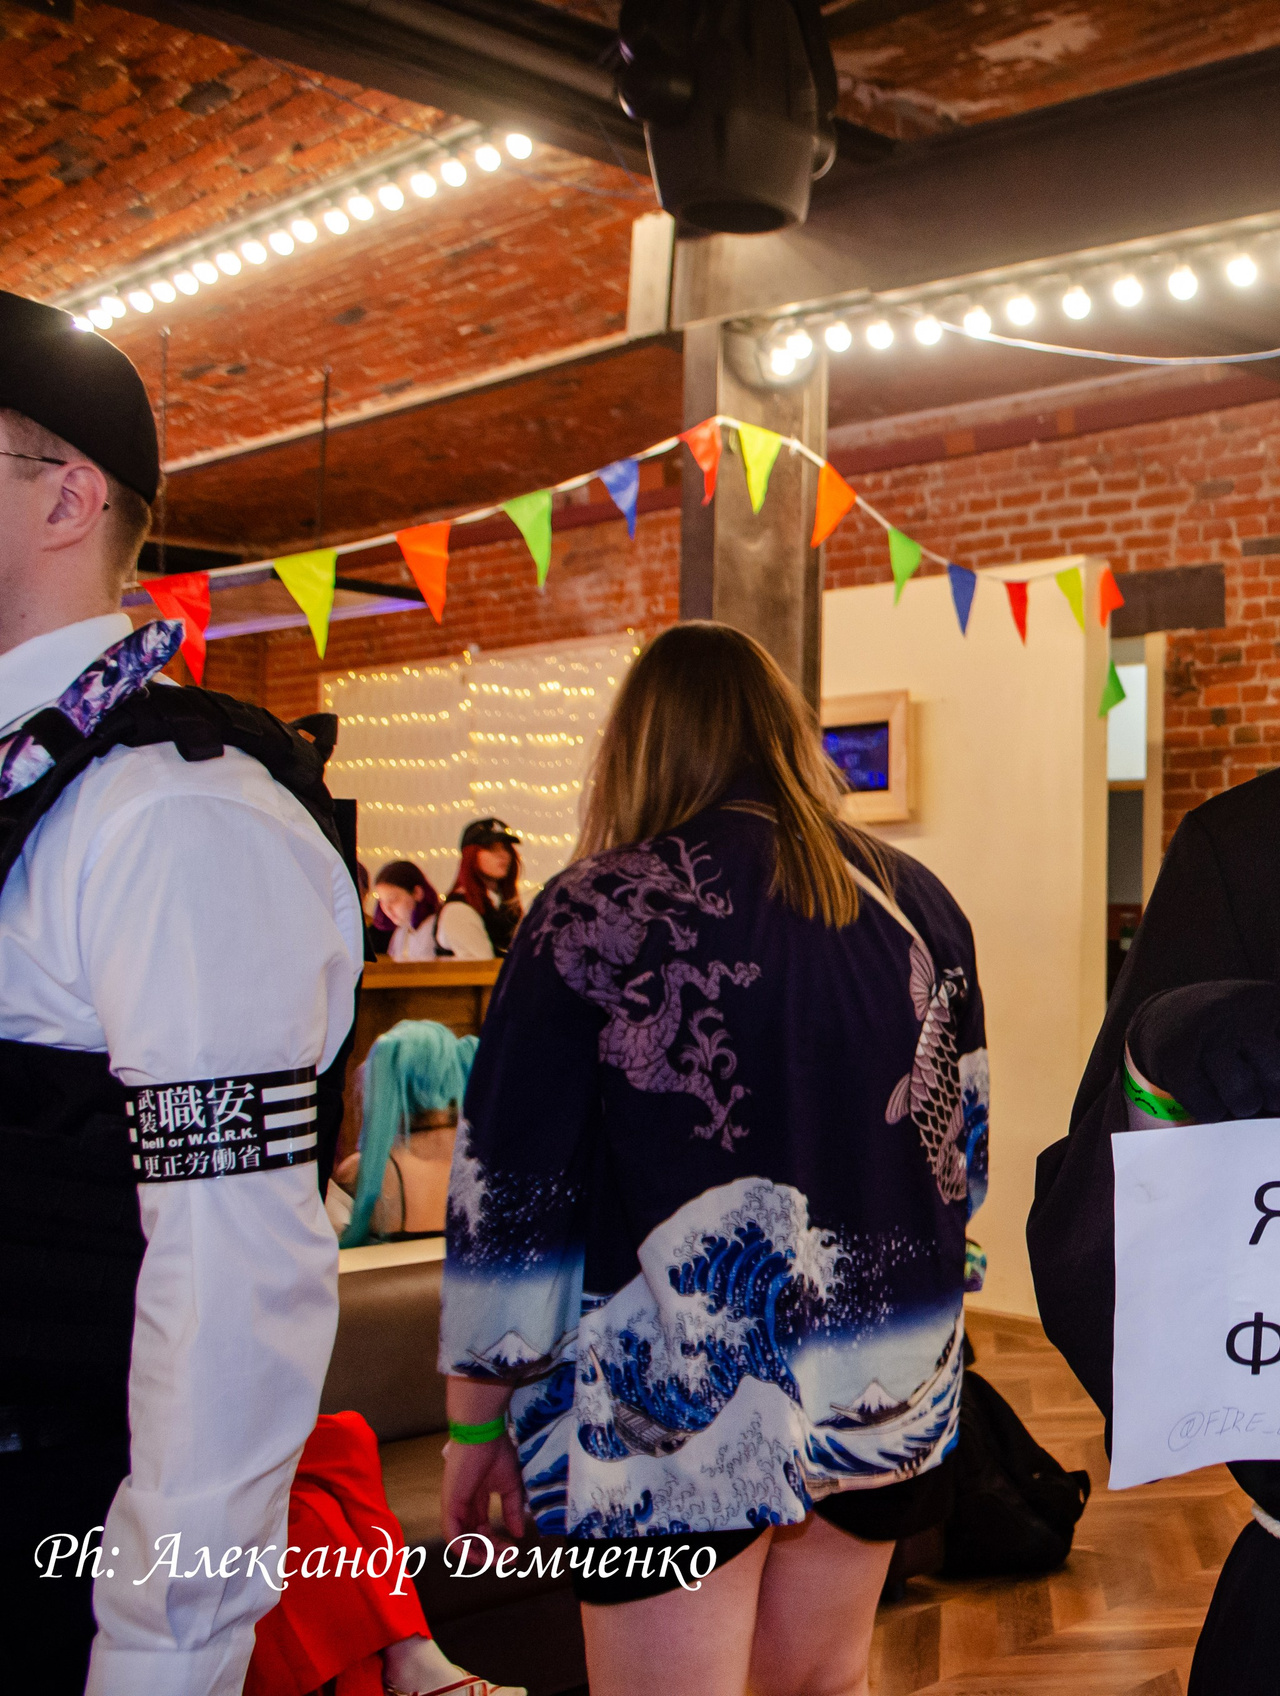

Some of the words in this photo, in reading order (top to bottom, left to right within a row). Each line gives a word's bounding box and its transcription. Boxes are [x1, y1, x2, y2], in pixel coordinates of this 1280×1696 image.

[138, 1089, 157, 1134] 武装
[157, 1080, 255, 1133] 職安
[142, 1137, 164, 1150] hell
[168, 1138, 185, 1148] or
[188, 1127, 258, 1147] W.O.R.K.
[143, 1144, 261, 1179] 更正労働省
